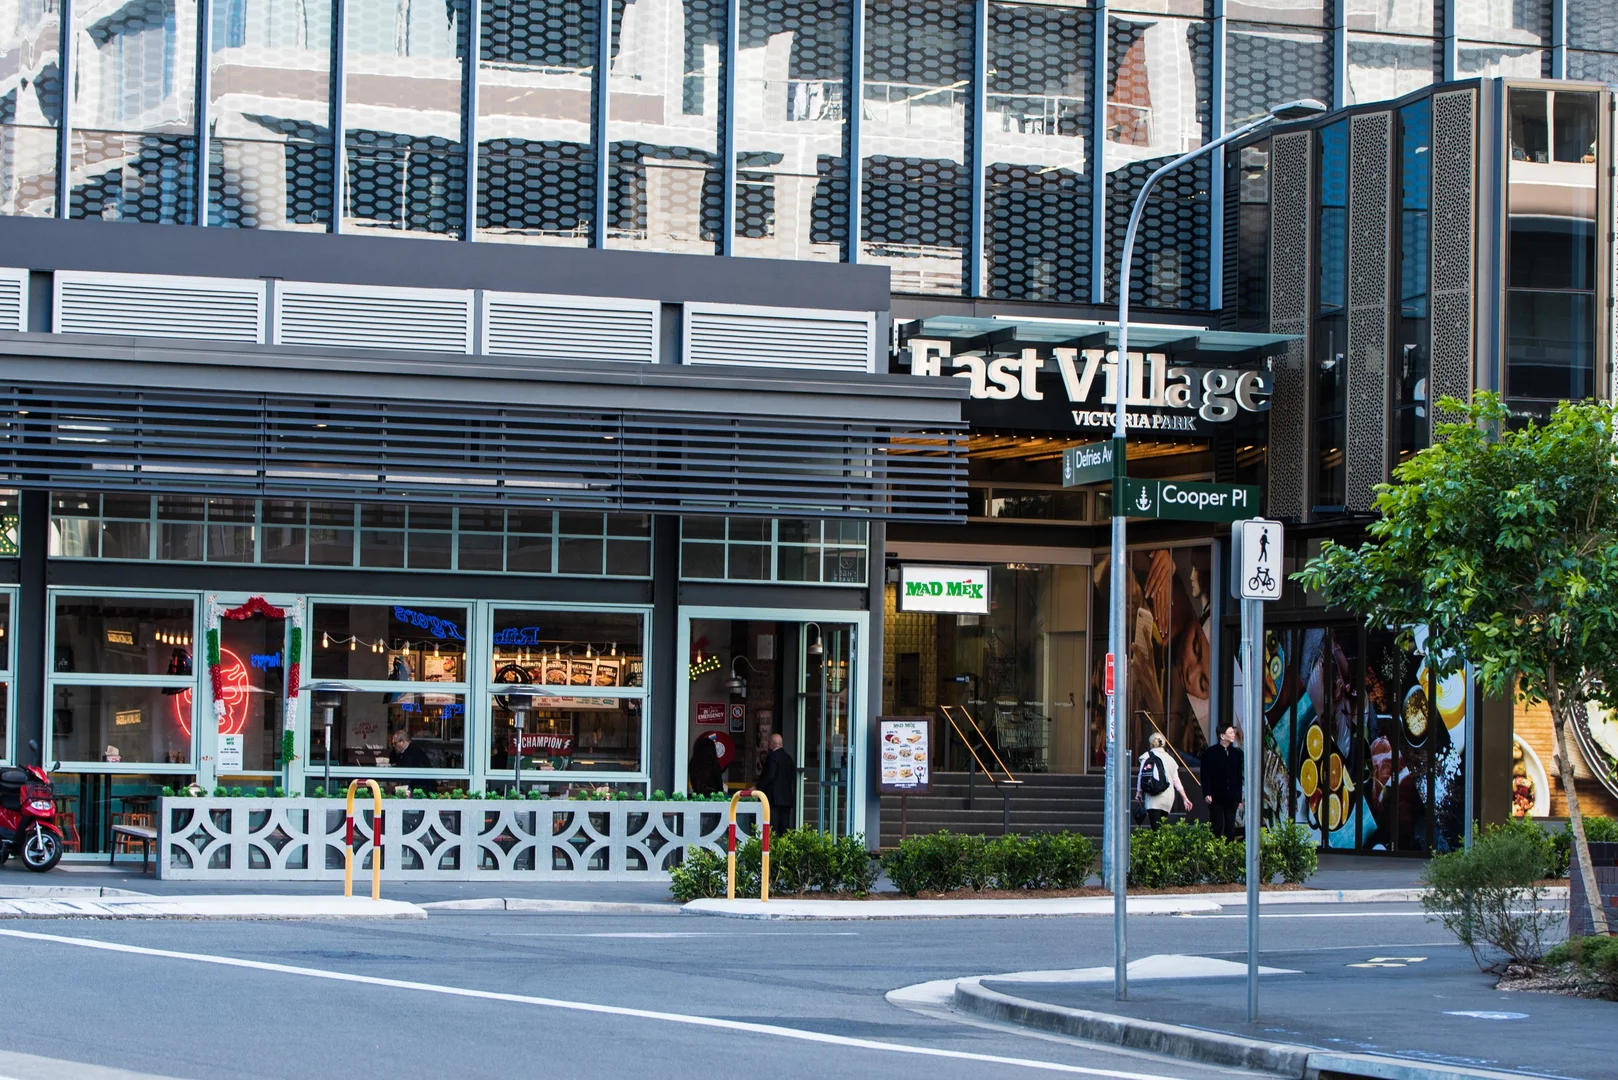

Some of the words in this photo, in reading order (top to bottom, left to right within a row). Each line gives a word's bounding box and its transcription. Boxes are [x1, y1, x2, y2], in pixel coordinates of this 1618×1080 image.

[908, 339, 1044, 400] East
[1052, 347, 1274, 422] Village
[1152, 414, 1197, 431] PARK
[1076, 448, 1101, 469] Defries
[1102, 446, 1113, 464] Av
[1163, 485, 1227, 510] Cooper
[1232, 489, 1247, 507] Pl
[906, 582, 943, 597] MAD
[946, 580, 983, 599] MEX
[522, 736, 562, 750] CHAMPION
